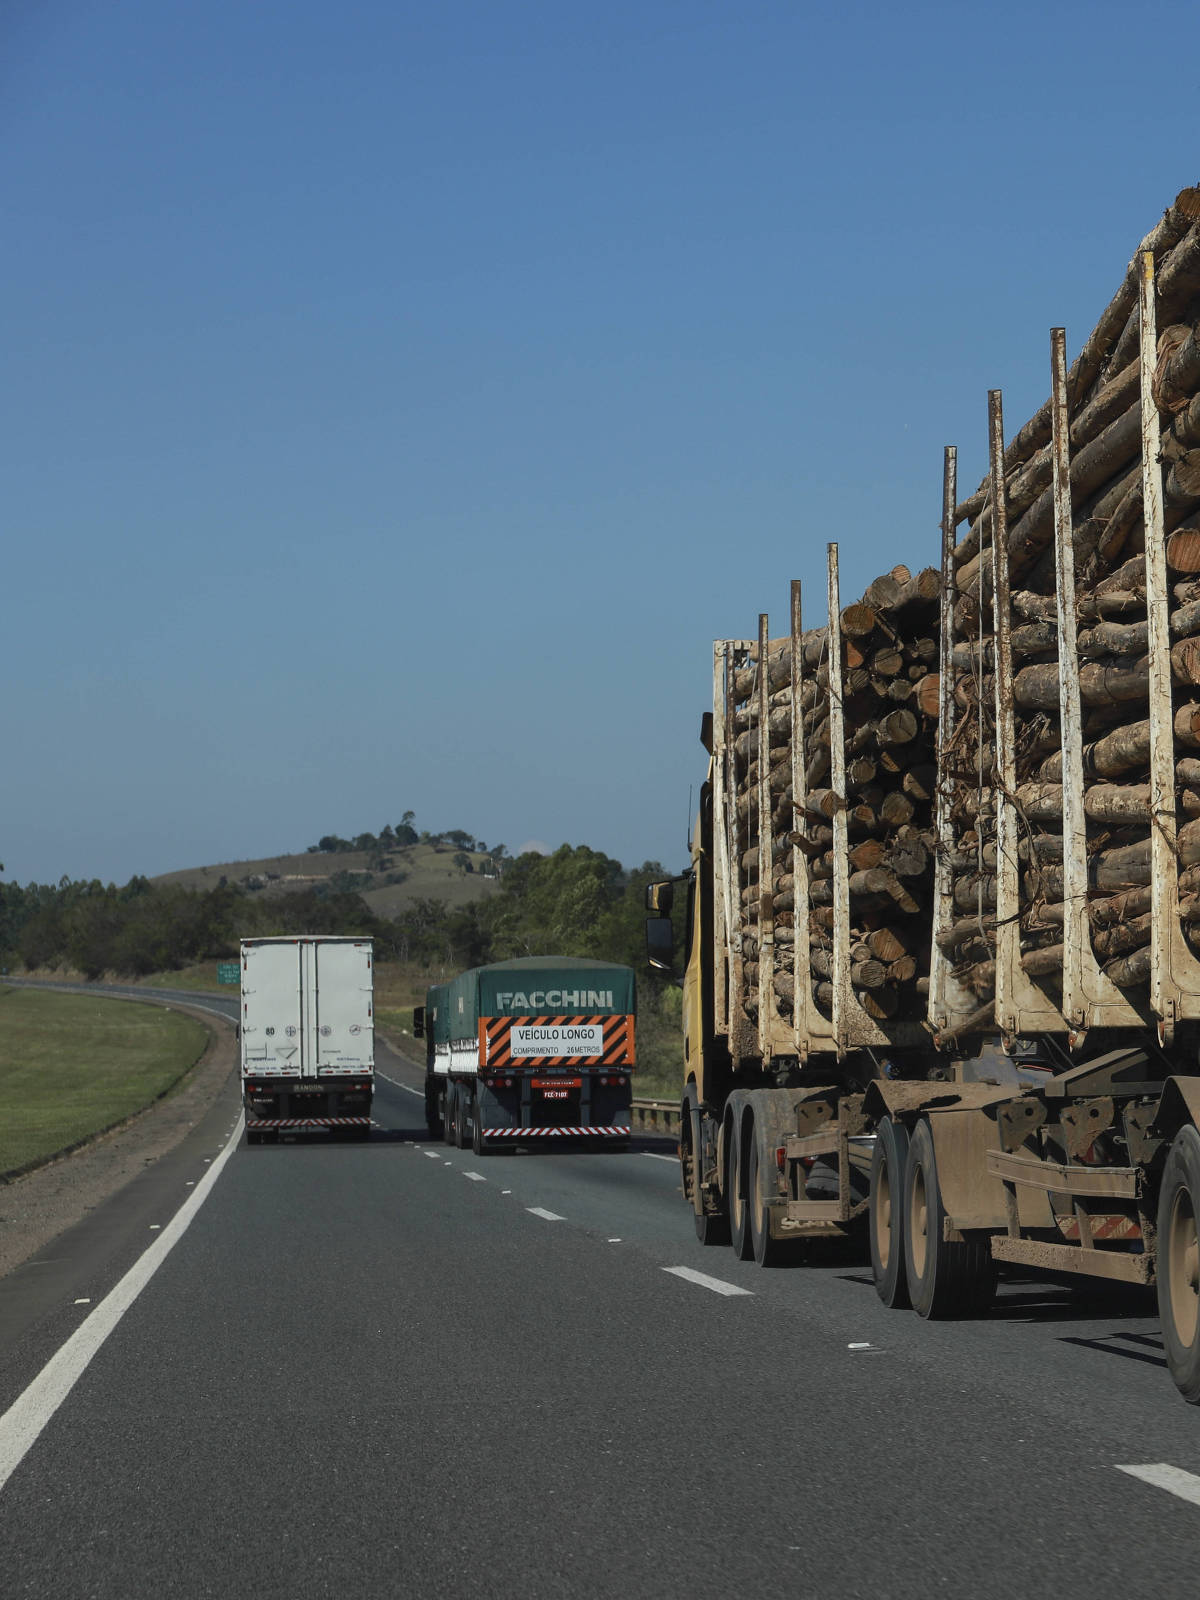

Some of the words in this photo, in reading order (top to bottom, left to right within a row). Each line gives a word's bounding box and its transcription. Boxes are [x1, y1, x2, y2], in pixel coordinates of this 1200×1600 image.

[496, 990, 613, 1009] FACCHINI
[265, 1027, 275, 1036] 80
[518, 1028, 559, 1040] VEÍCULO
[561, 1029, 595, 1040] LONGO
[513, 1046, 559, 1054] COMPRIMENTO
